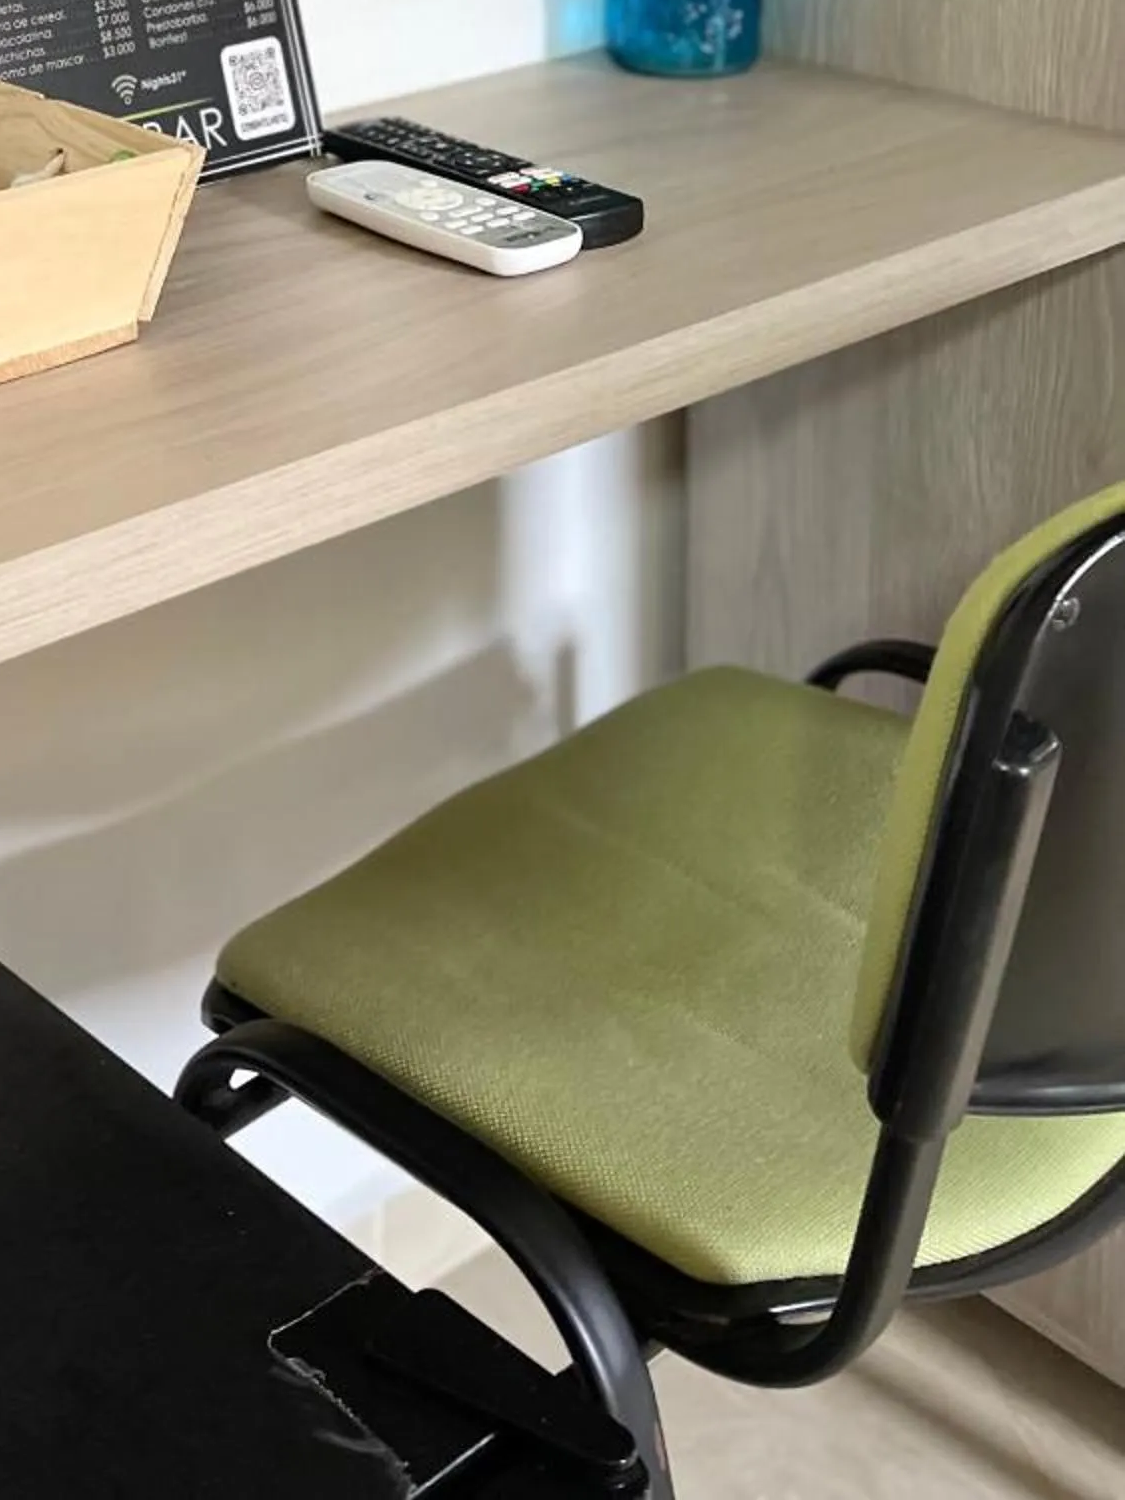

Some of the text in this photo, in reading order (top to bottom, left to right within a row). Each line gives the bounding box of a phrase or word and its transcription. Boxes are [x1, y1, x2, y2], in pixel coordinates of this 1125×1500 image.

[13, 17, 28, 30] de
[28, 62, 44, 76] de
[46, 54, 85, 72] mascar
